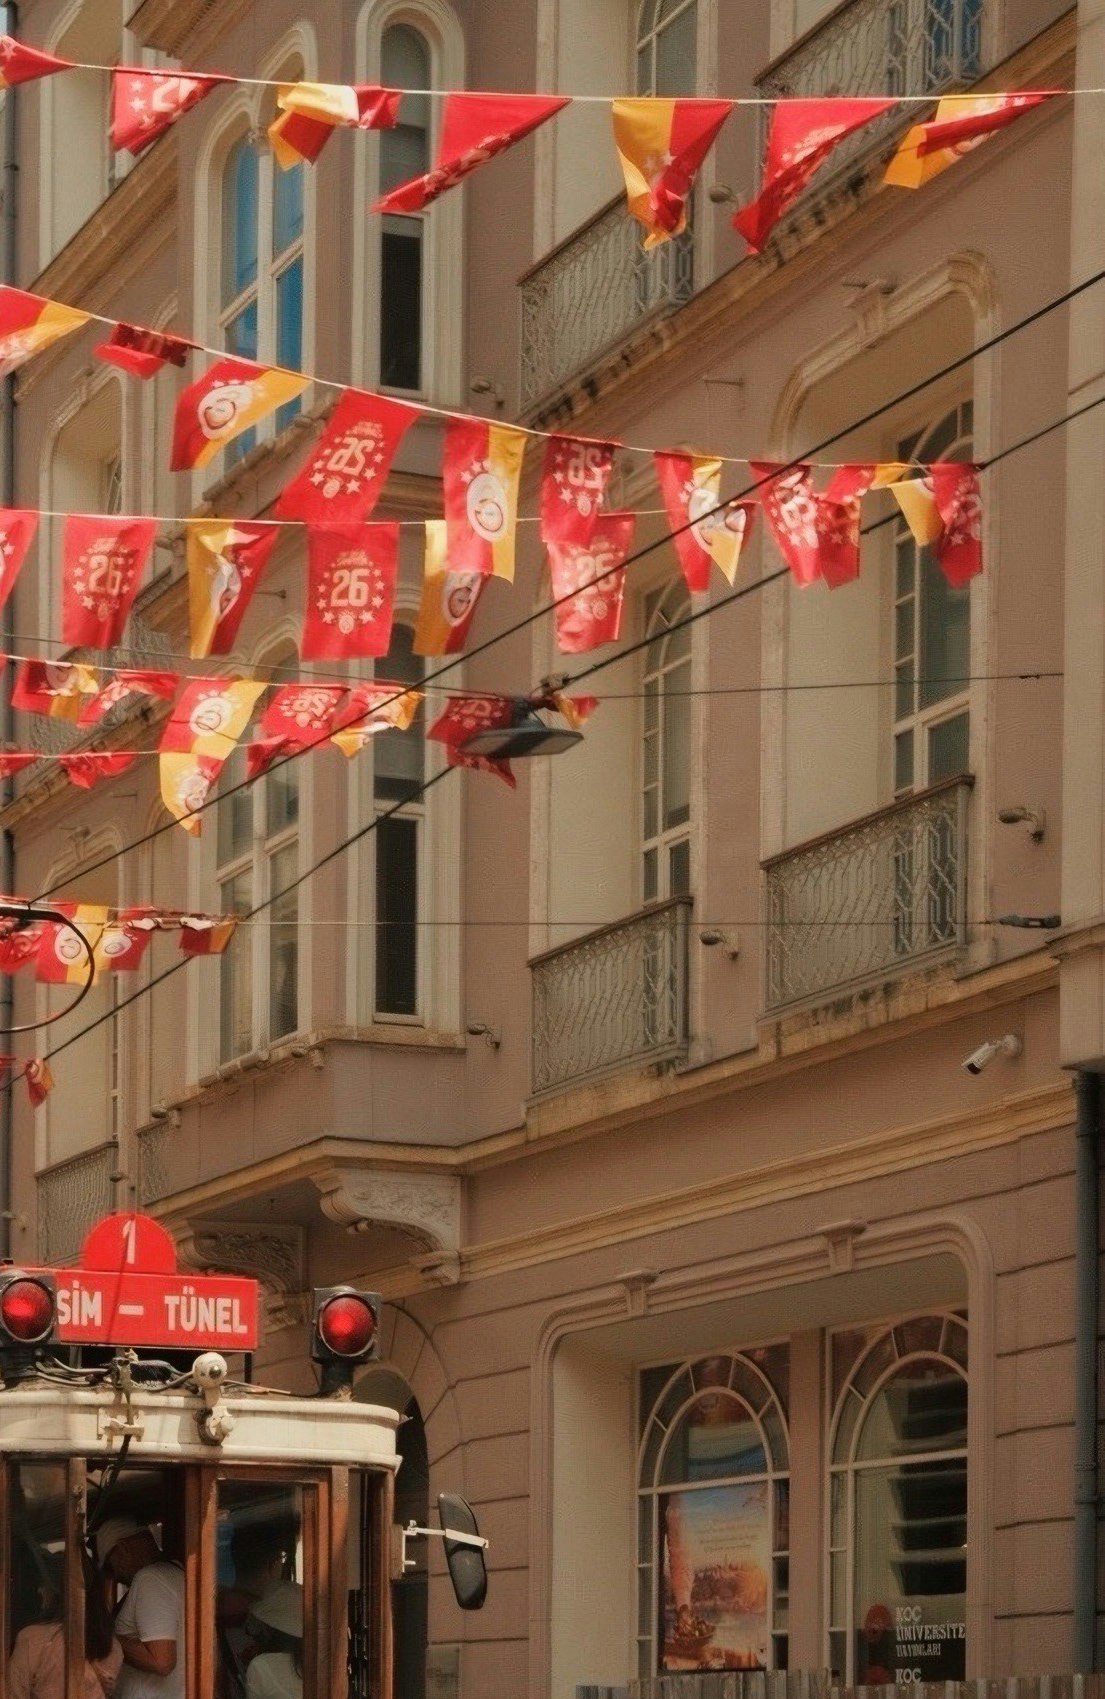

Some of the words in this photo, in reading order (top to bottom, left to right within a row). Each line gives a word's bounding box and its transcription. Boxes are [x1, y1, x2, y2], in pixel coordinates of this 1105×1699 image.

[89, 554, 122, 597] 26
[331, 569, 371, 607] 26
[122, 1218, 136, 1265] 1
[56, 1279, 102, 1327] SİM
[164, 1285, 248, 1334] TÜNEL
